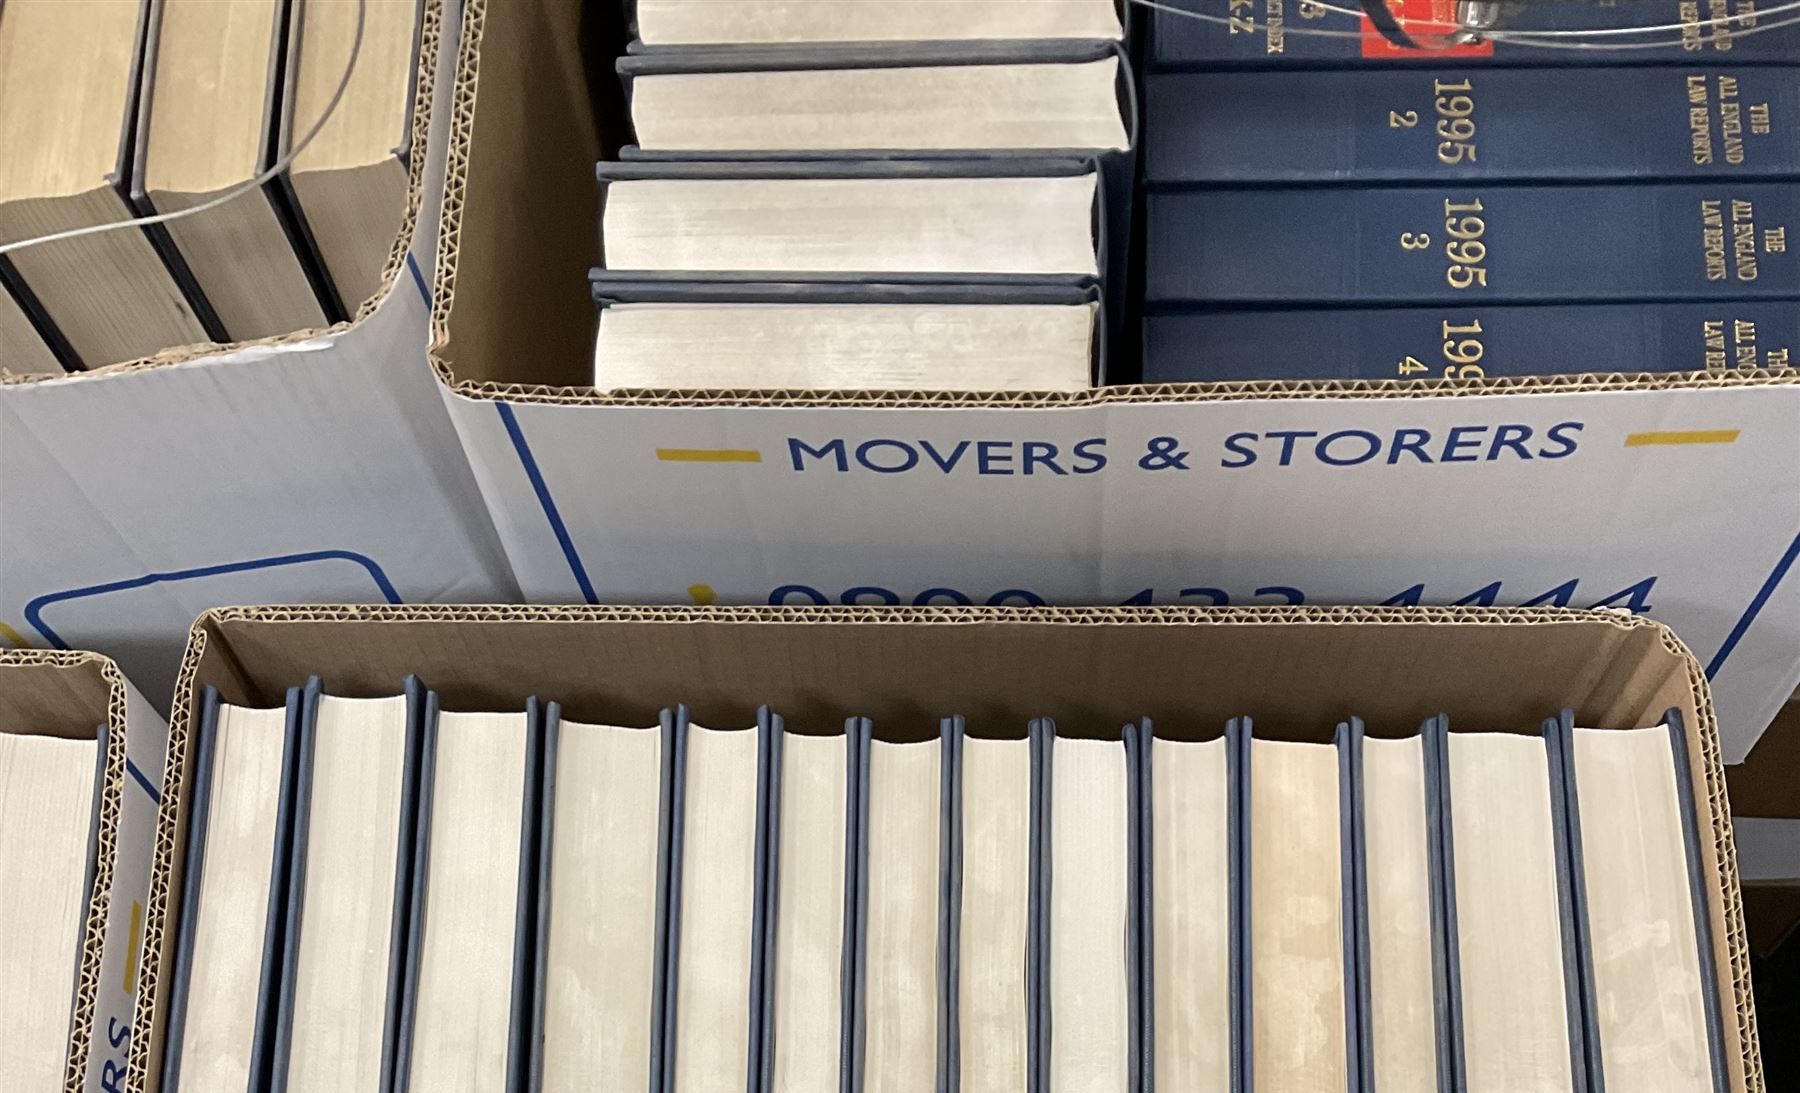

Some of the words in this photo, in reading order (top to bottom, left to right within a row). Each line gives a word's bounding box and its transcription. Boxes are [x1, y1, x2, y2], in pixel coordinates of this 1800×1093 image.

[1687, 75, 1707, 105] LAW
[1718, 76, 1738, 99] ALL
[1389, 110, 1418, 128] 2
[1434, 78, 1476, 164] 1995
[1720, 102, 1744, 164] ENGLAND
[1750, 102, 1770, 134] THE
[1690, 107, 1713, 164] REPORTS
[1702, 200, 1723, 228] LAW
[1732, 200, 1752, 222] ALL
[1401, 232, 1430, 250] 3
[1444, 198, 1487, 289] 1995
[1704, 228, 1727, 280] REPORTS
[1734, 223, 1758, 281] ENGLAND
[1764, 226, 1786, 252] THE
[1704, 320, 1724, 350] LAW
[1735, 319, 1755, 343] ALL
[1443, 319, 1485, 380] 199
[1768, 348, 1788, 369] TH
[1399, 356, 1429, 375] 4
[787, 437, 1108, 476] MOVERS
[1138, 437, 1190, 471] &
[1220, 421, 1585, 468] STORERS
